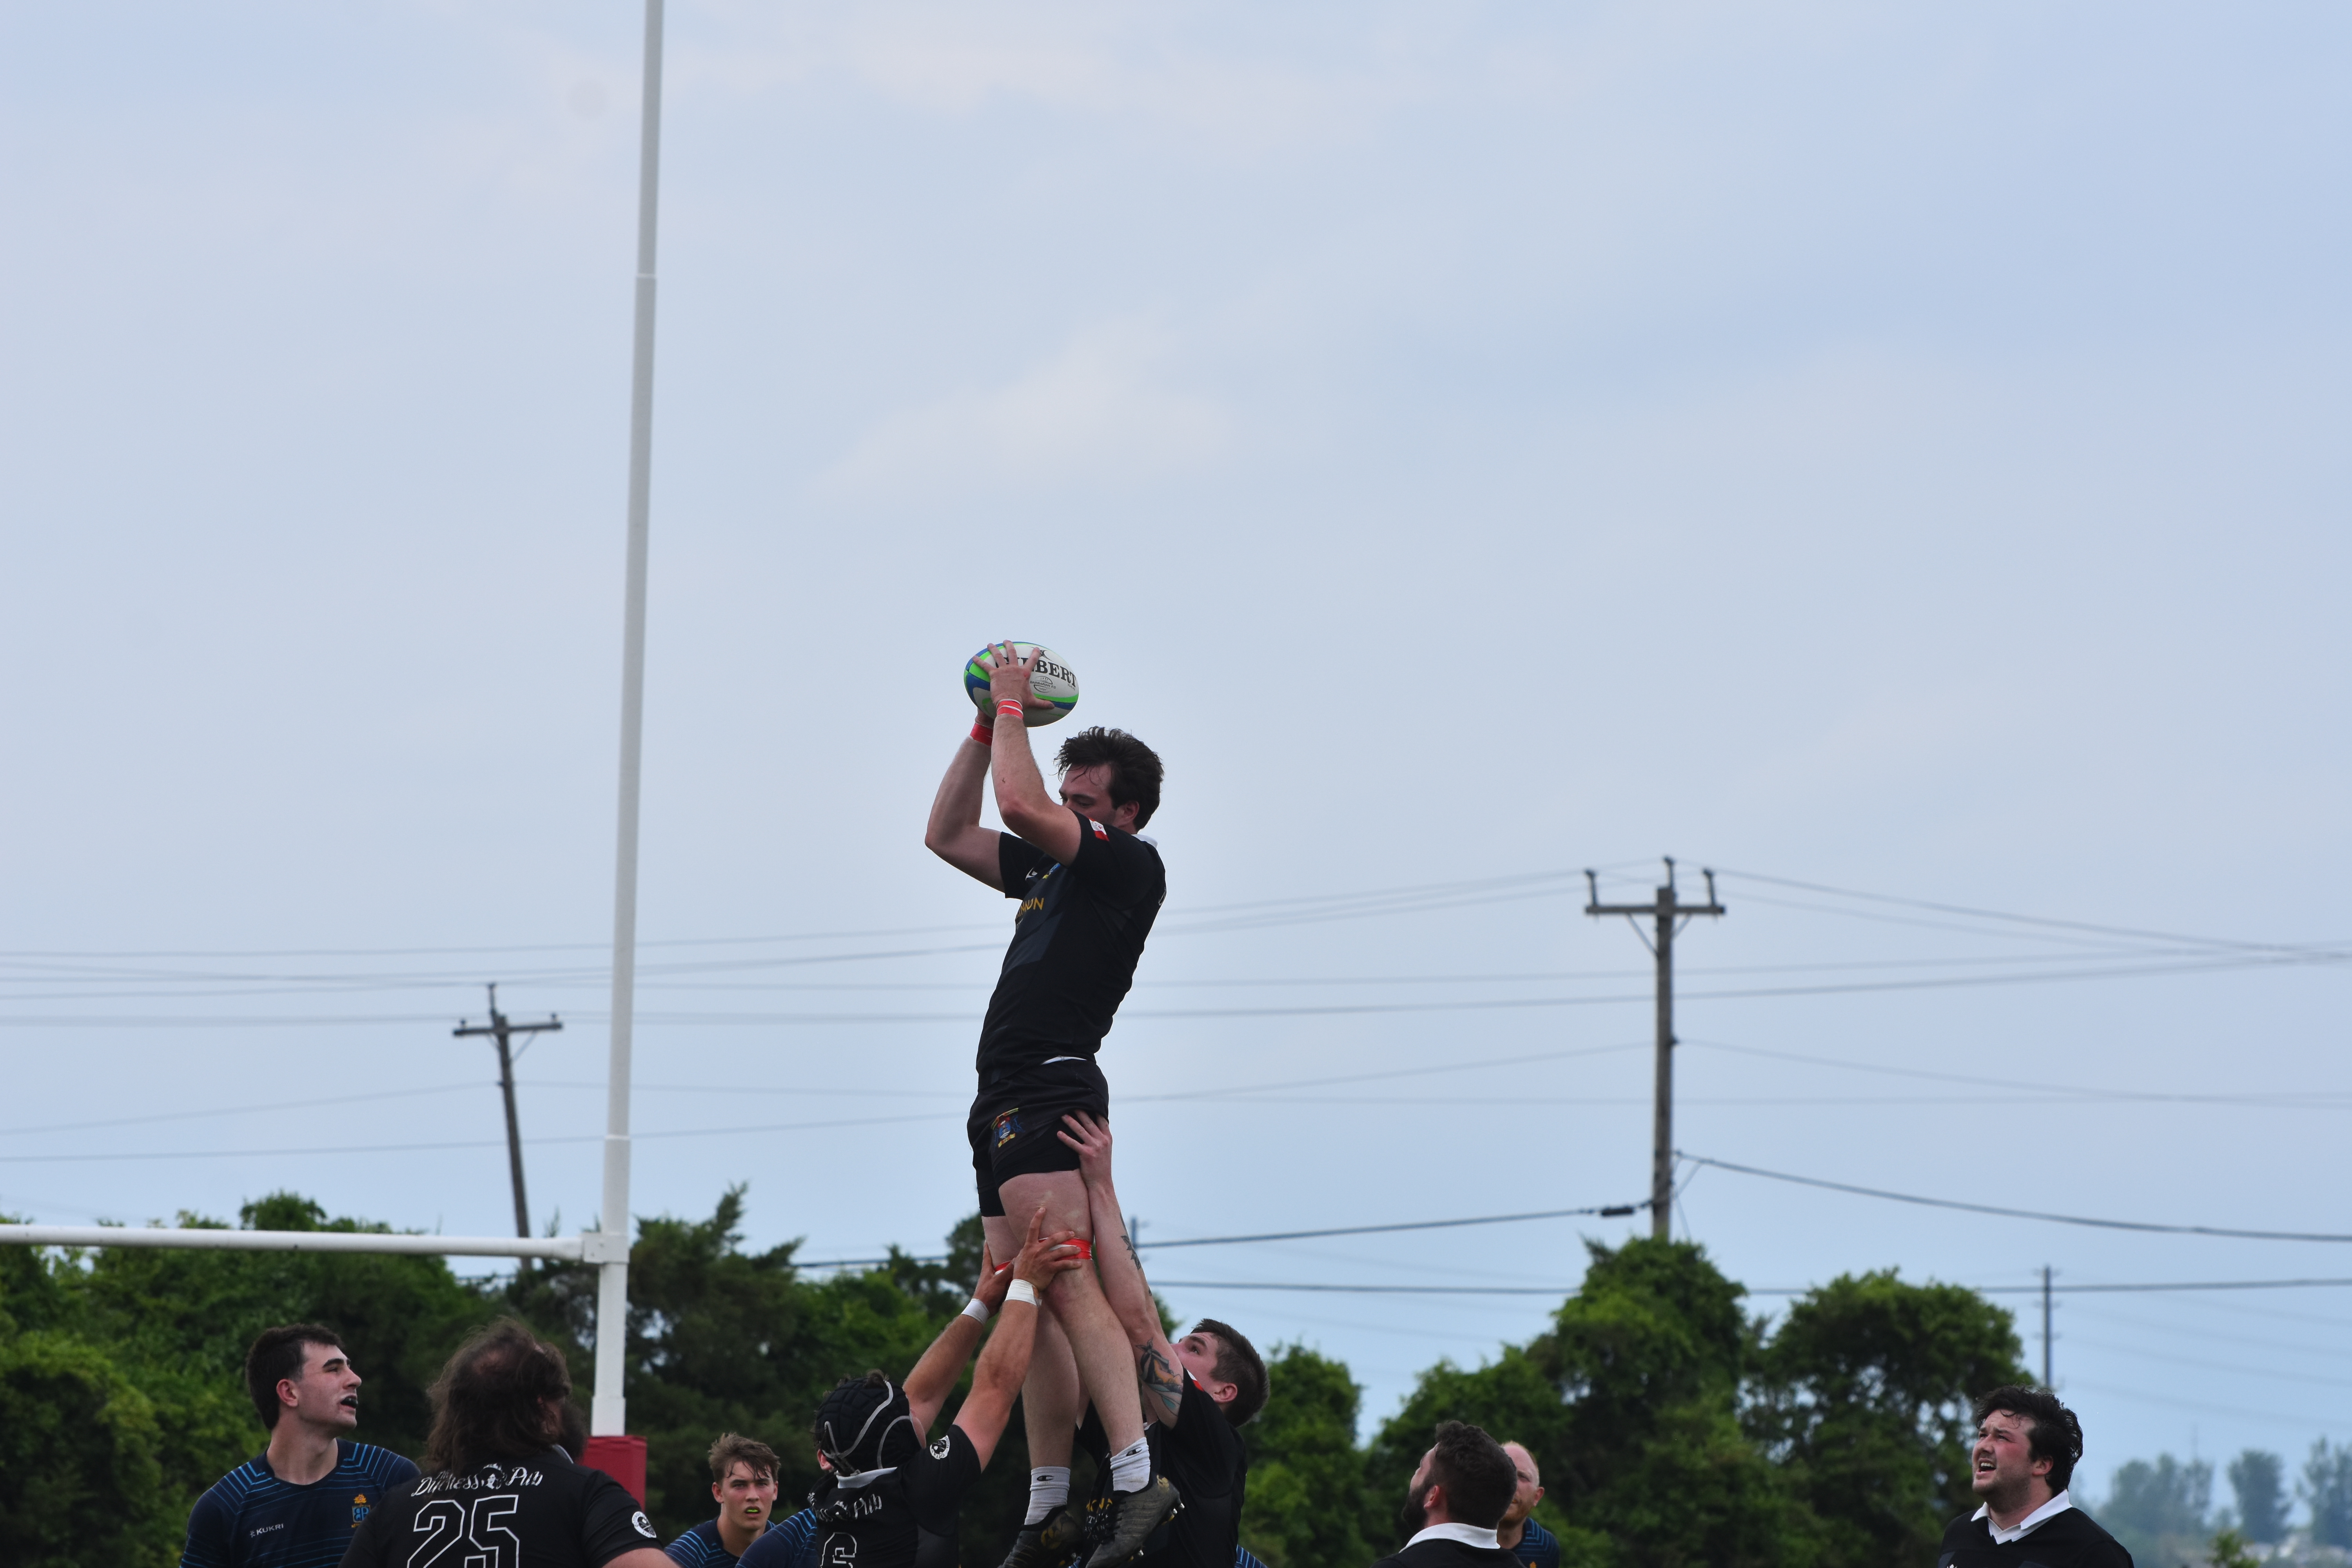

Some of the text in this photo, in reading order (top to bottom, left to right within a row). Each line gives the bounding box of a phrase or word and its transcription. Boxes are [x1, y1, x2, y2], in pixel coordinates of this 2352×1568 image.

[996, 657, 1076, 688] BERT
[256, 1523, 284, 1535] KUKRI
[407, 1494, 519, 1568] 25
